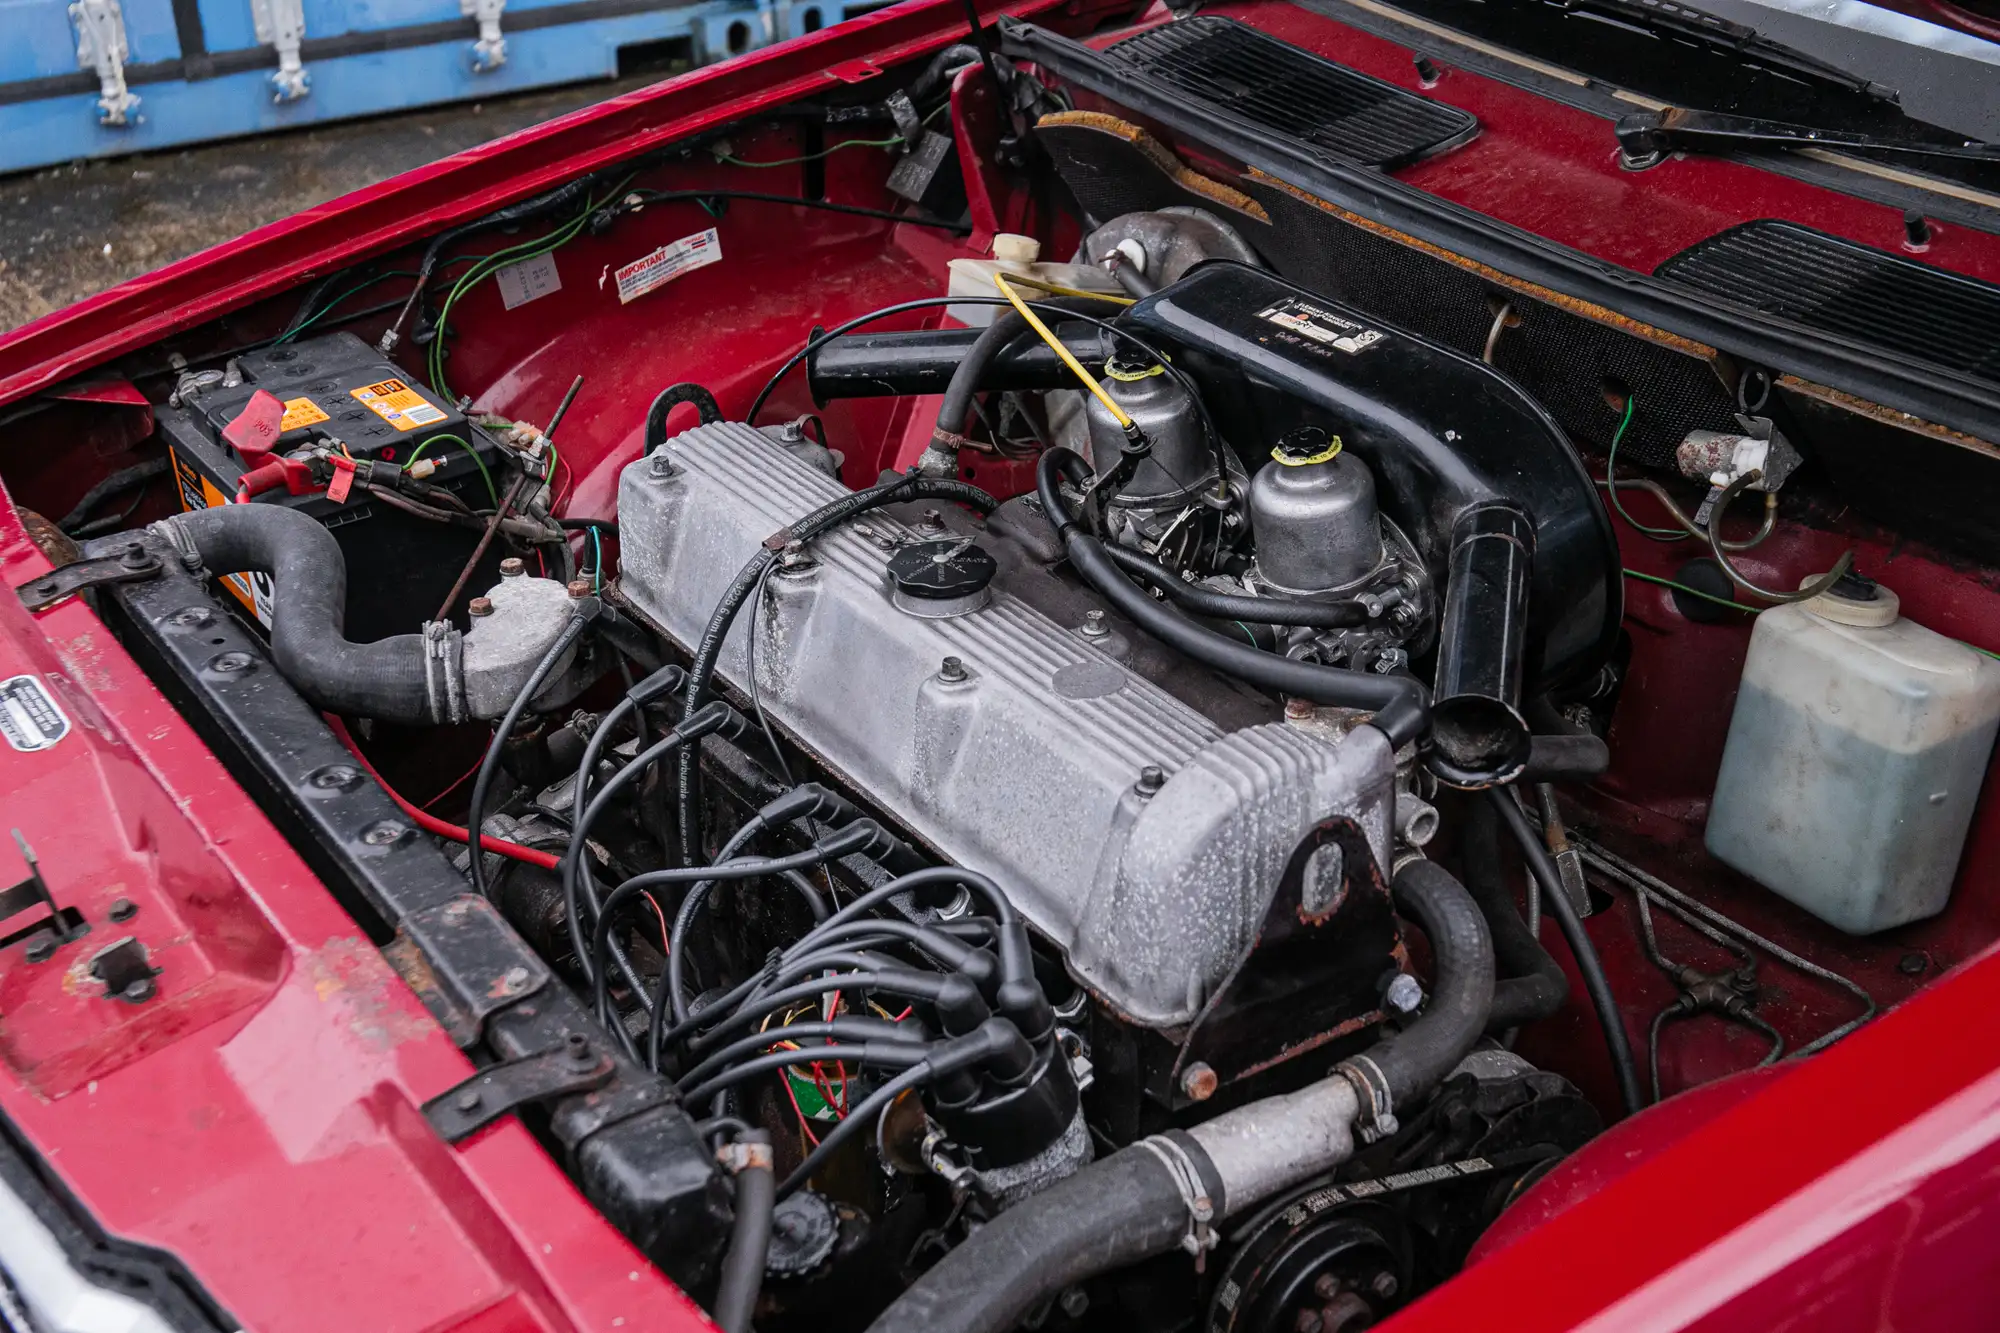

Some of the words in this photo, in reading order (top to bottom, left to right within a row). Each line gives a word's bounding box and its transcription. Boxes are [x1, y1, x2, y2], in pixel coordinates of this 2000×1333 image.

[617, 250, 666, 280] IMPORTANT
[711, 615, 725, 633] mm
[720, 607, 731, 616] 6
[693, 633, 718, 683] Universele
[680, 752, 691, 799] Carburante
